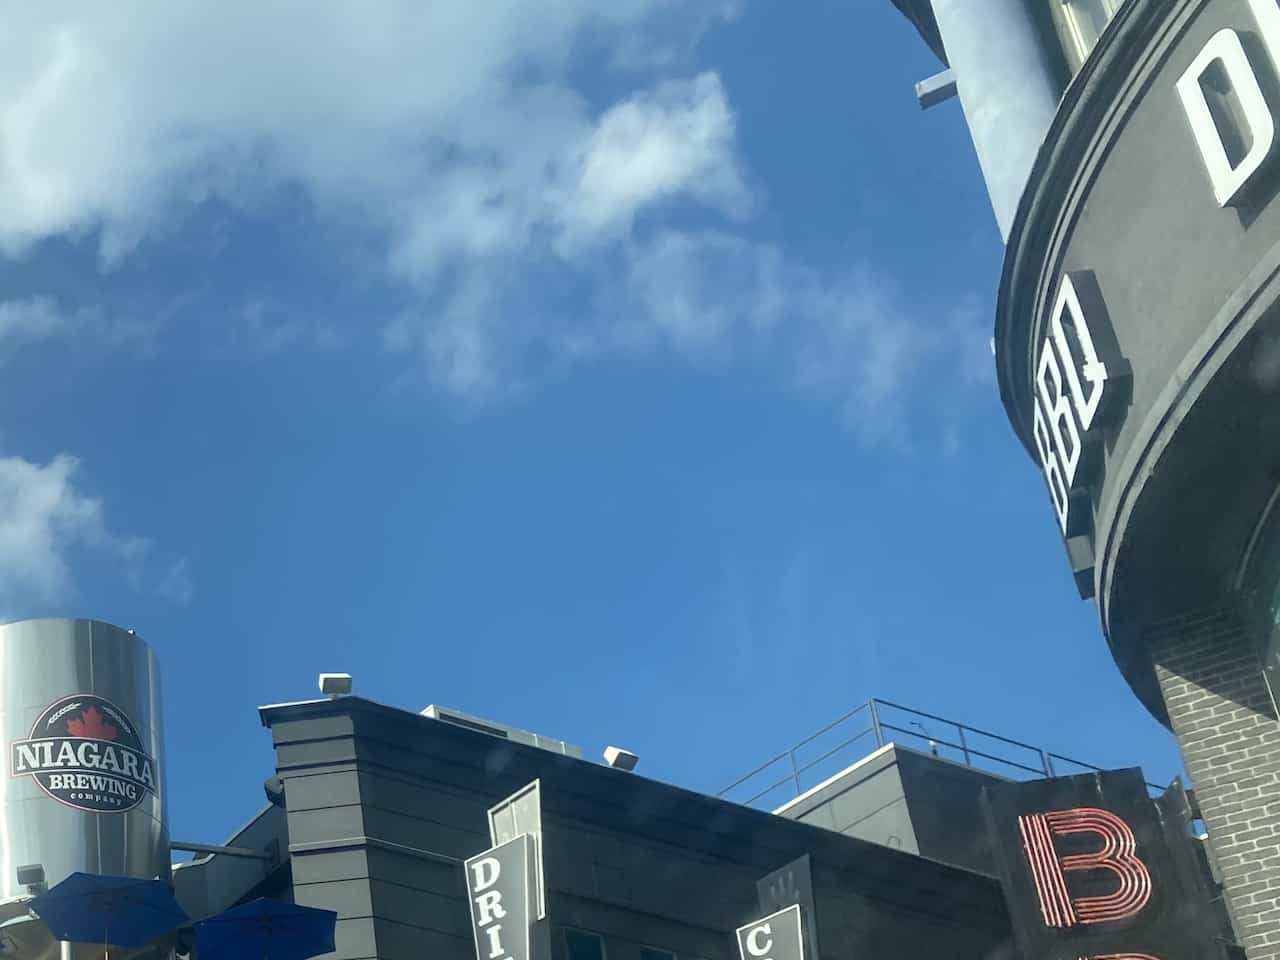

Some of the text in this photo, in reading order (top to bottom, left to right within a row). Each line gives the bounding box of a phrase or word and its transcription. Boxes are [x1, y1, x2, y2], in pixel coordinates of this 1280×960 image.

[15, 740, 155, 789] NIAGARA
[49, 773, 137, 801] BREWING
[70, 792, 121, 806] company
